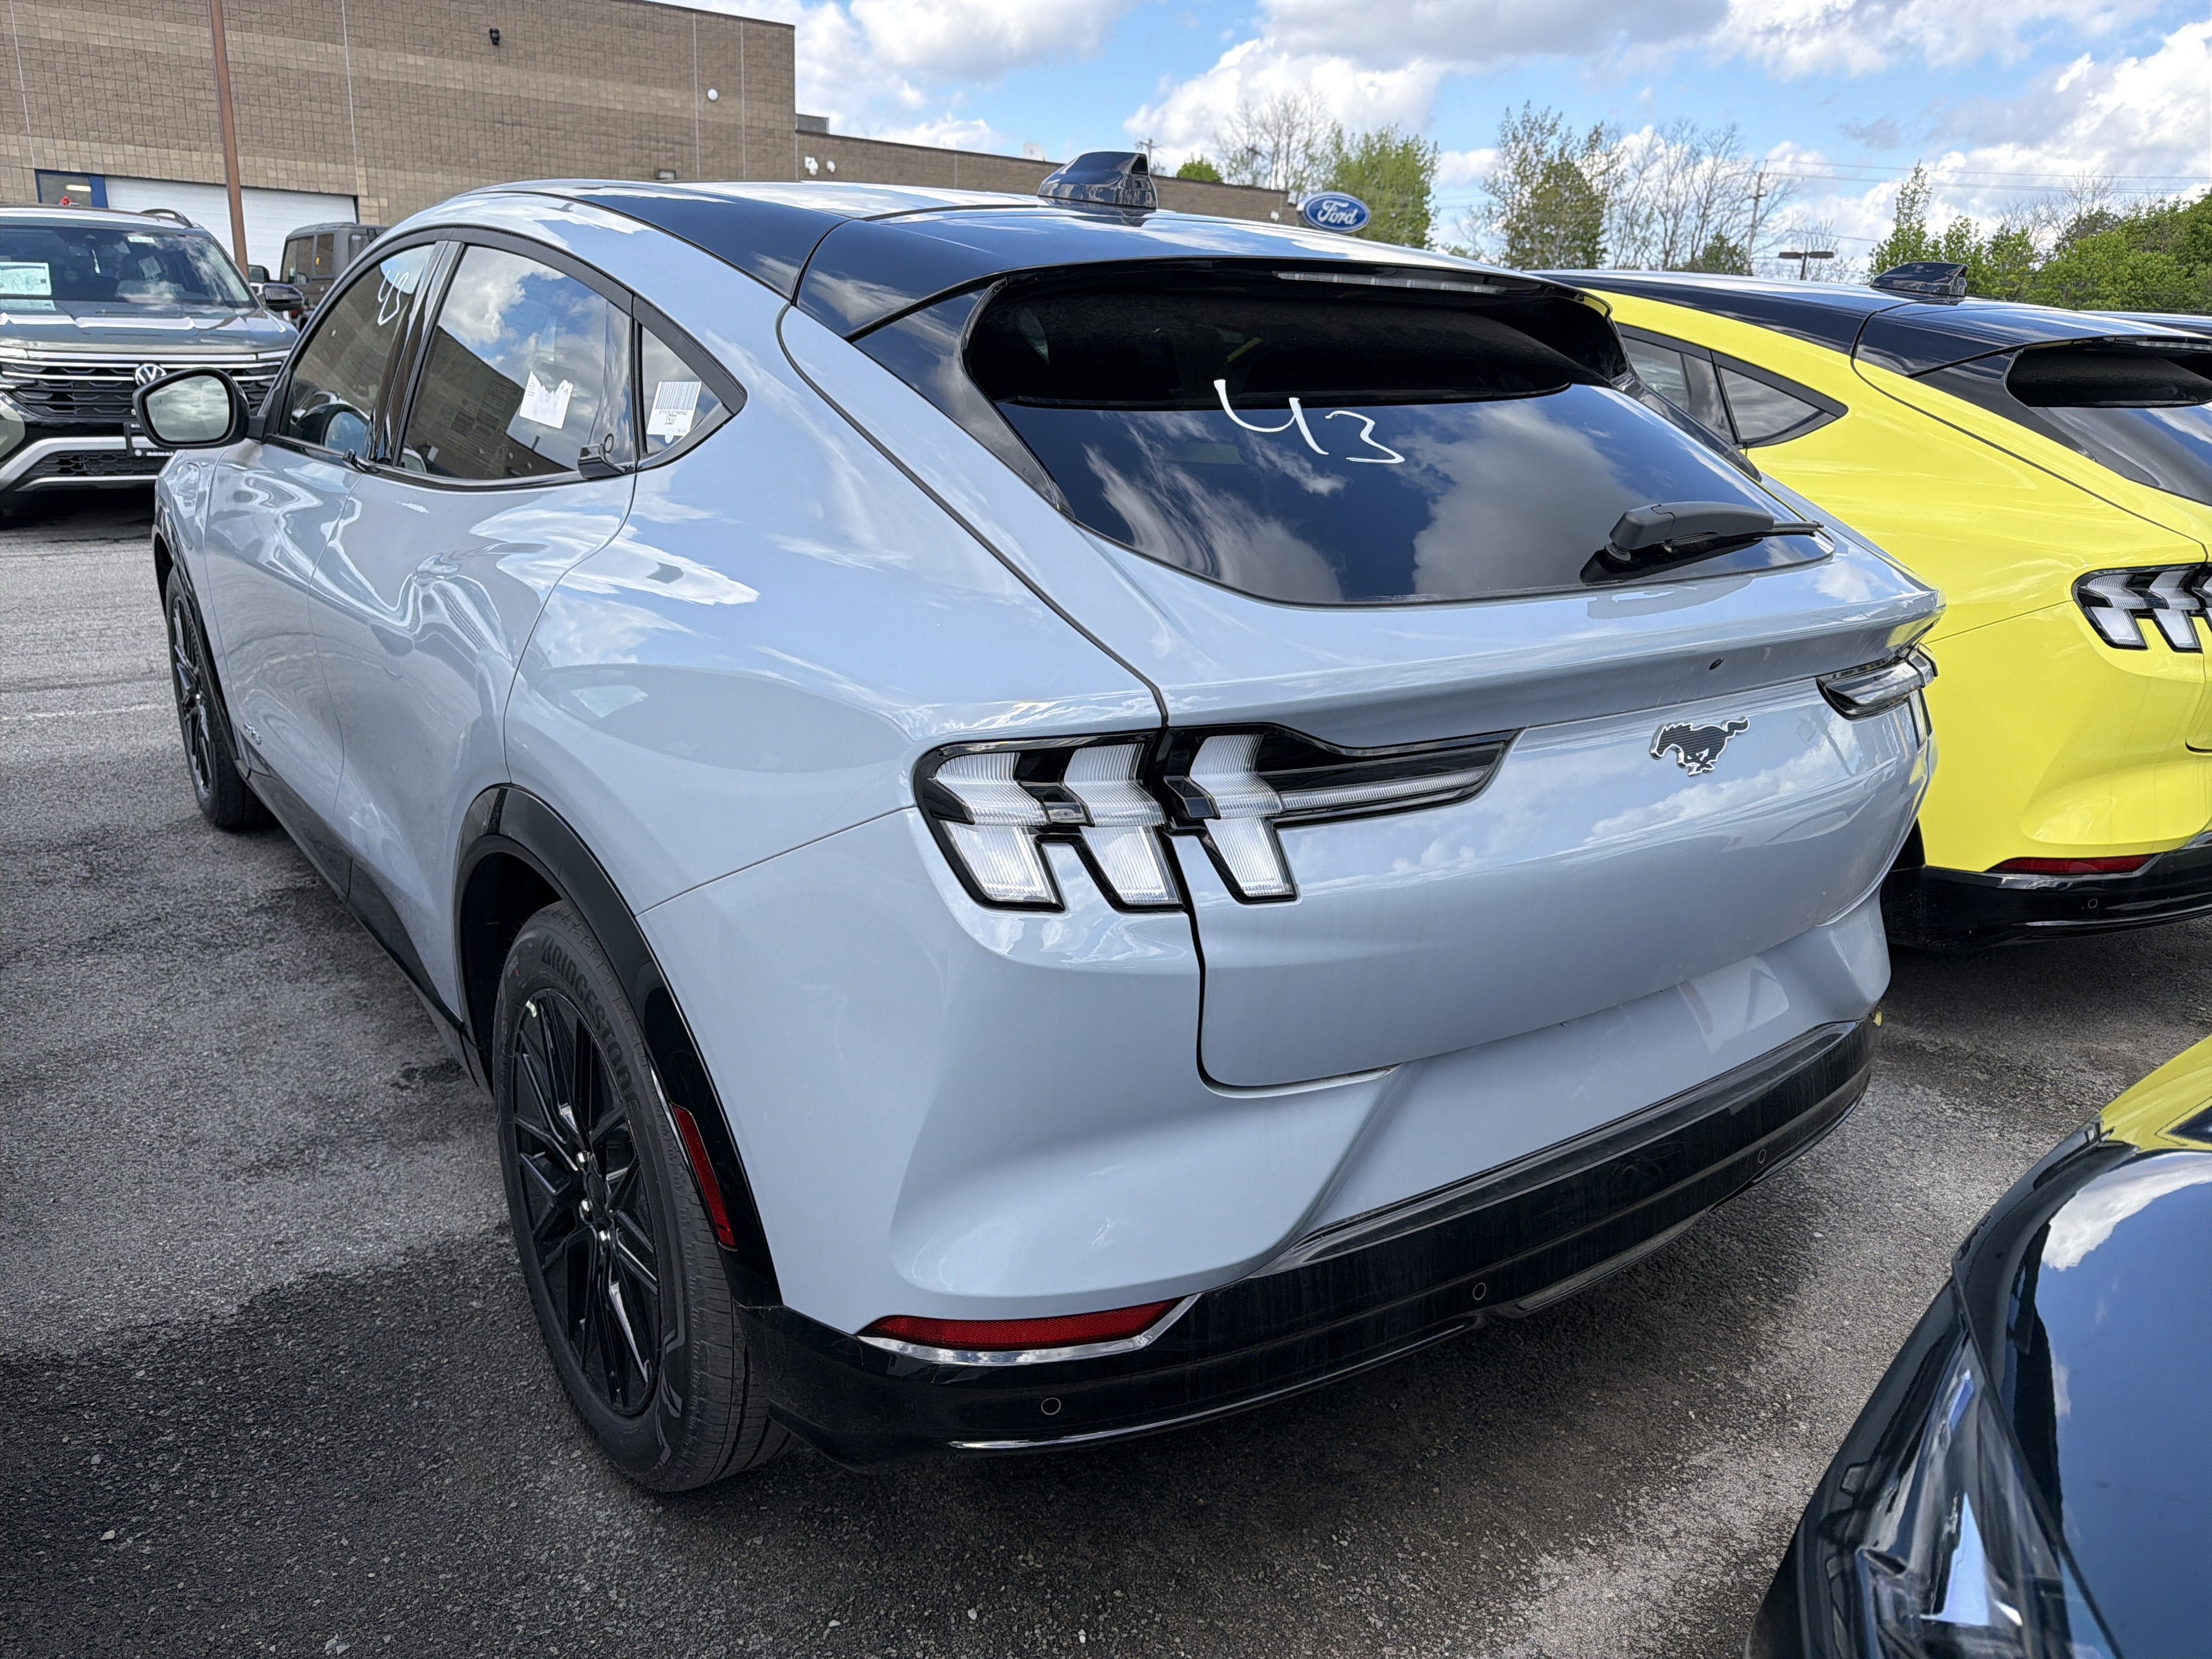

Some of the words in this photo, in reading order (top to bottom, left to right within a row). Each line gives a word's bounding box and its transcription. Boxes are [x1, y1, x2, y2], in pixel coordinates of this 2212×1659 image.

[1317, 200, 1358, 225] Ford
[1214, 379, 1405, 463] 43
[541, 933, 641, 1112] BRIDGESTONE
